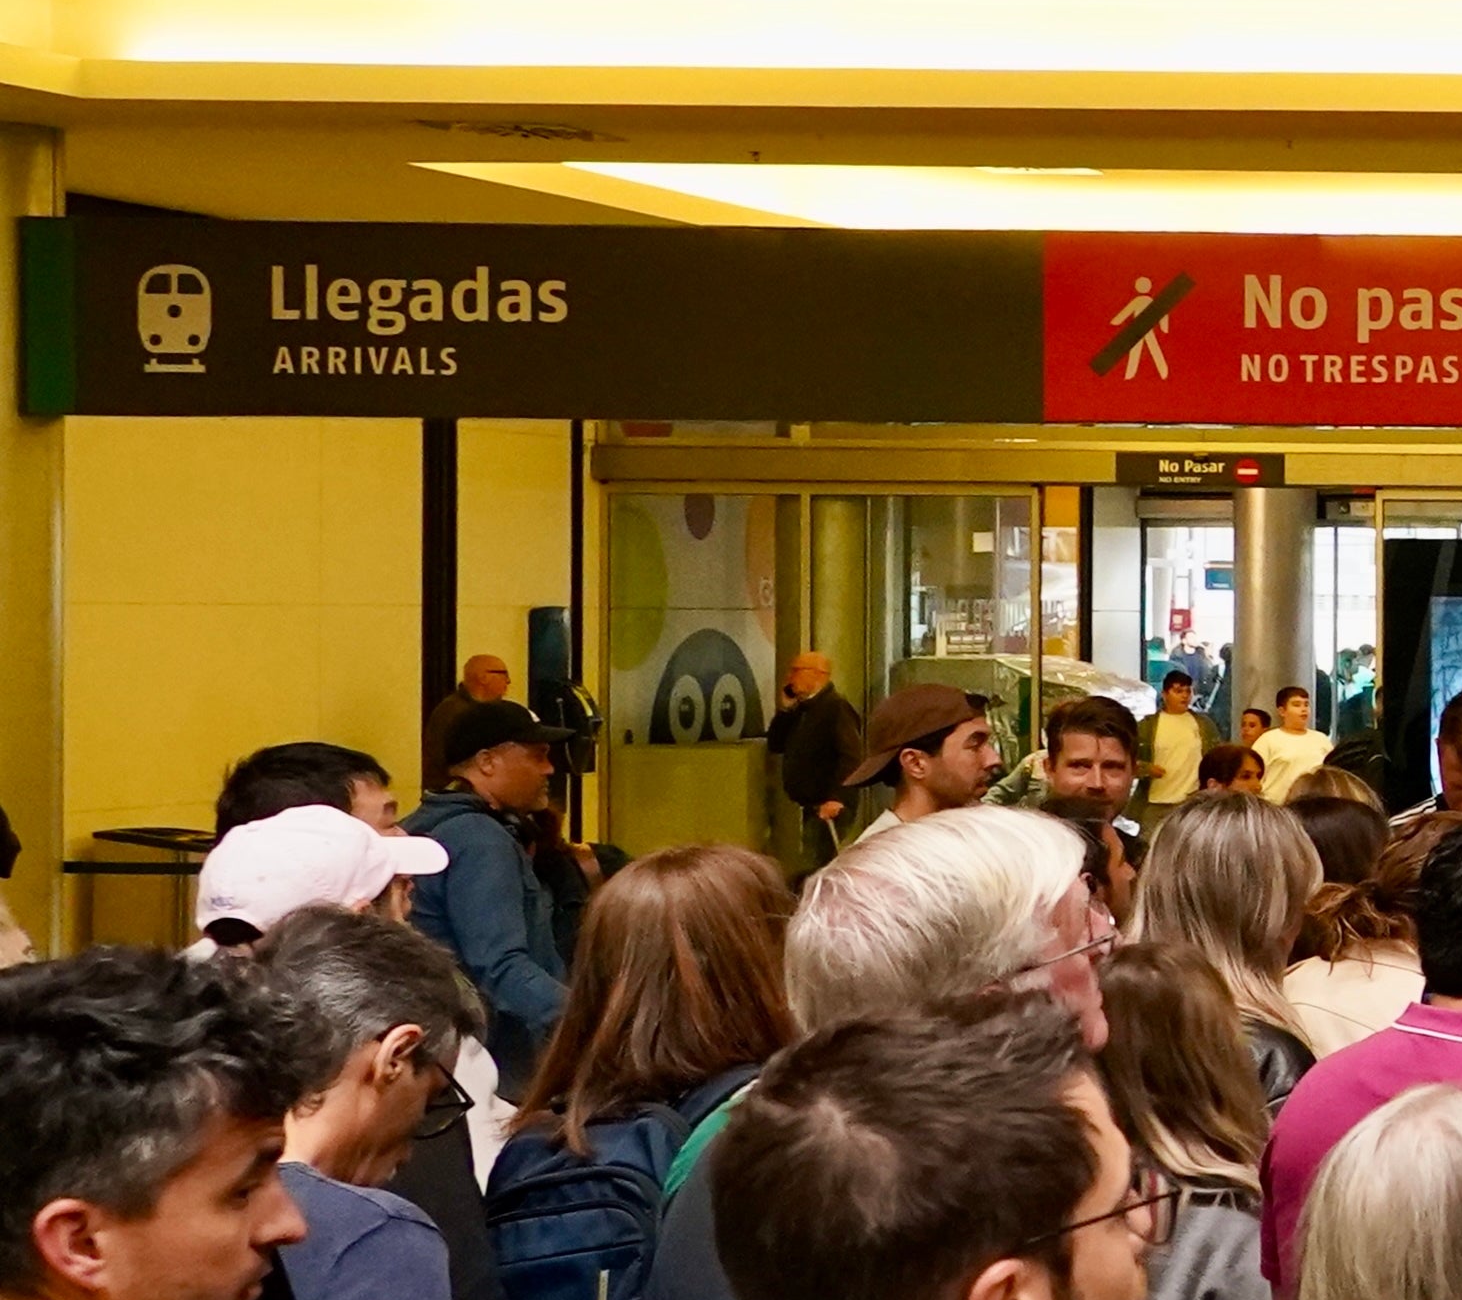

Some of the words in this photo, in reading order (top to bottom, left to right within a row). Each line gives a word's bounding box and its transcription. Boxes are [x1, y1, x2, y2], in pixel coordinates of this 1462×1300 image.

[271, 265, 568, 335] Llegadas
[1244, 273, 1327, 329] No
[273, 347, 459, 376] ARRIVALS
[1241, 354, 1288, 384] NO
[1159, 458, 1179, 474] No
[1184, 458, 1225, 474] Pasar
